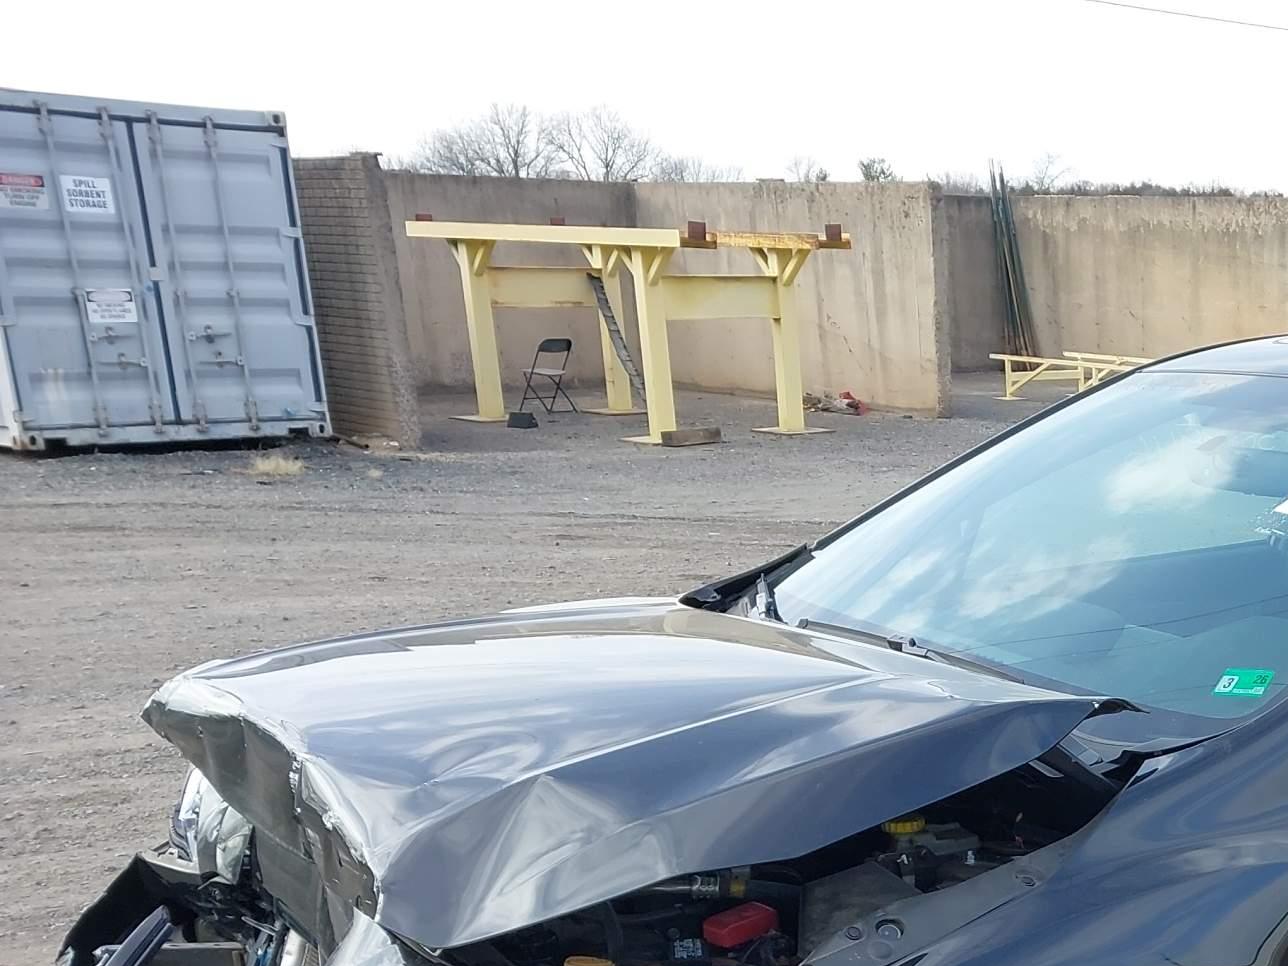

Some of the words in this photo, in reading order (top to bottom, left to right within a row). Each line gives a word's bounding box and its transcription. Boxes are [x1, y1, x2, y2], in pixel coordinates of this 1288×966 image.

[72, 179, 97, 188] SPILL
[66, 189, 106, 198] SORBENT
[68, 199, 107, 208] STORAGE
